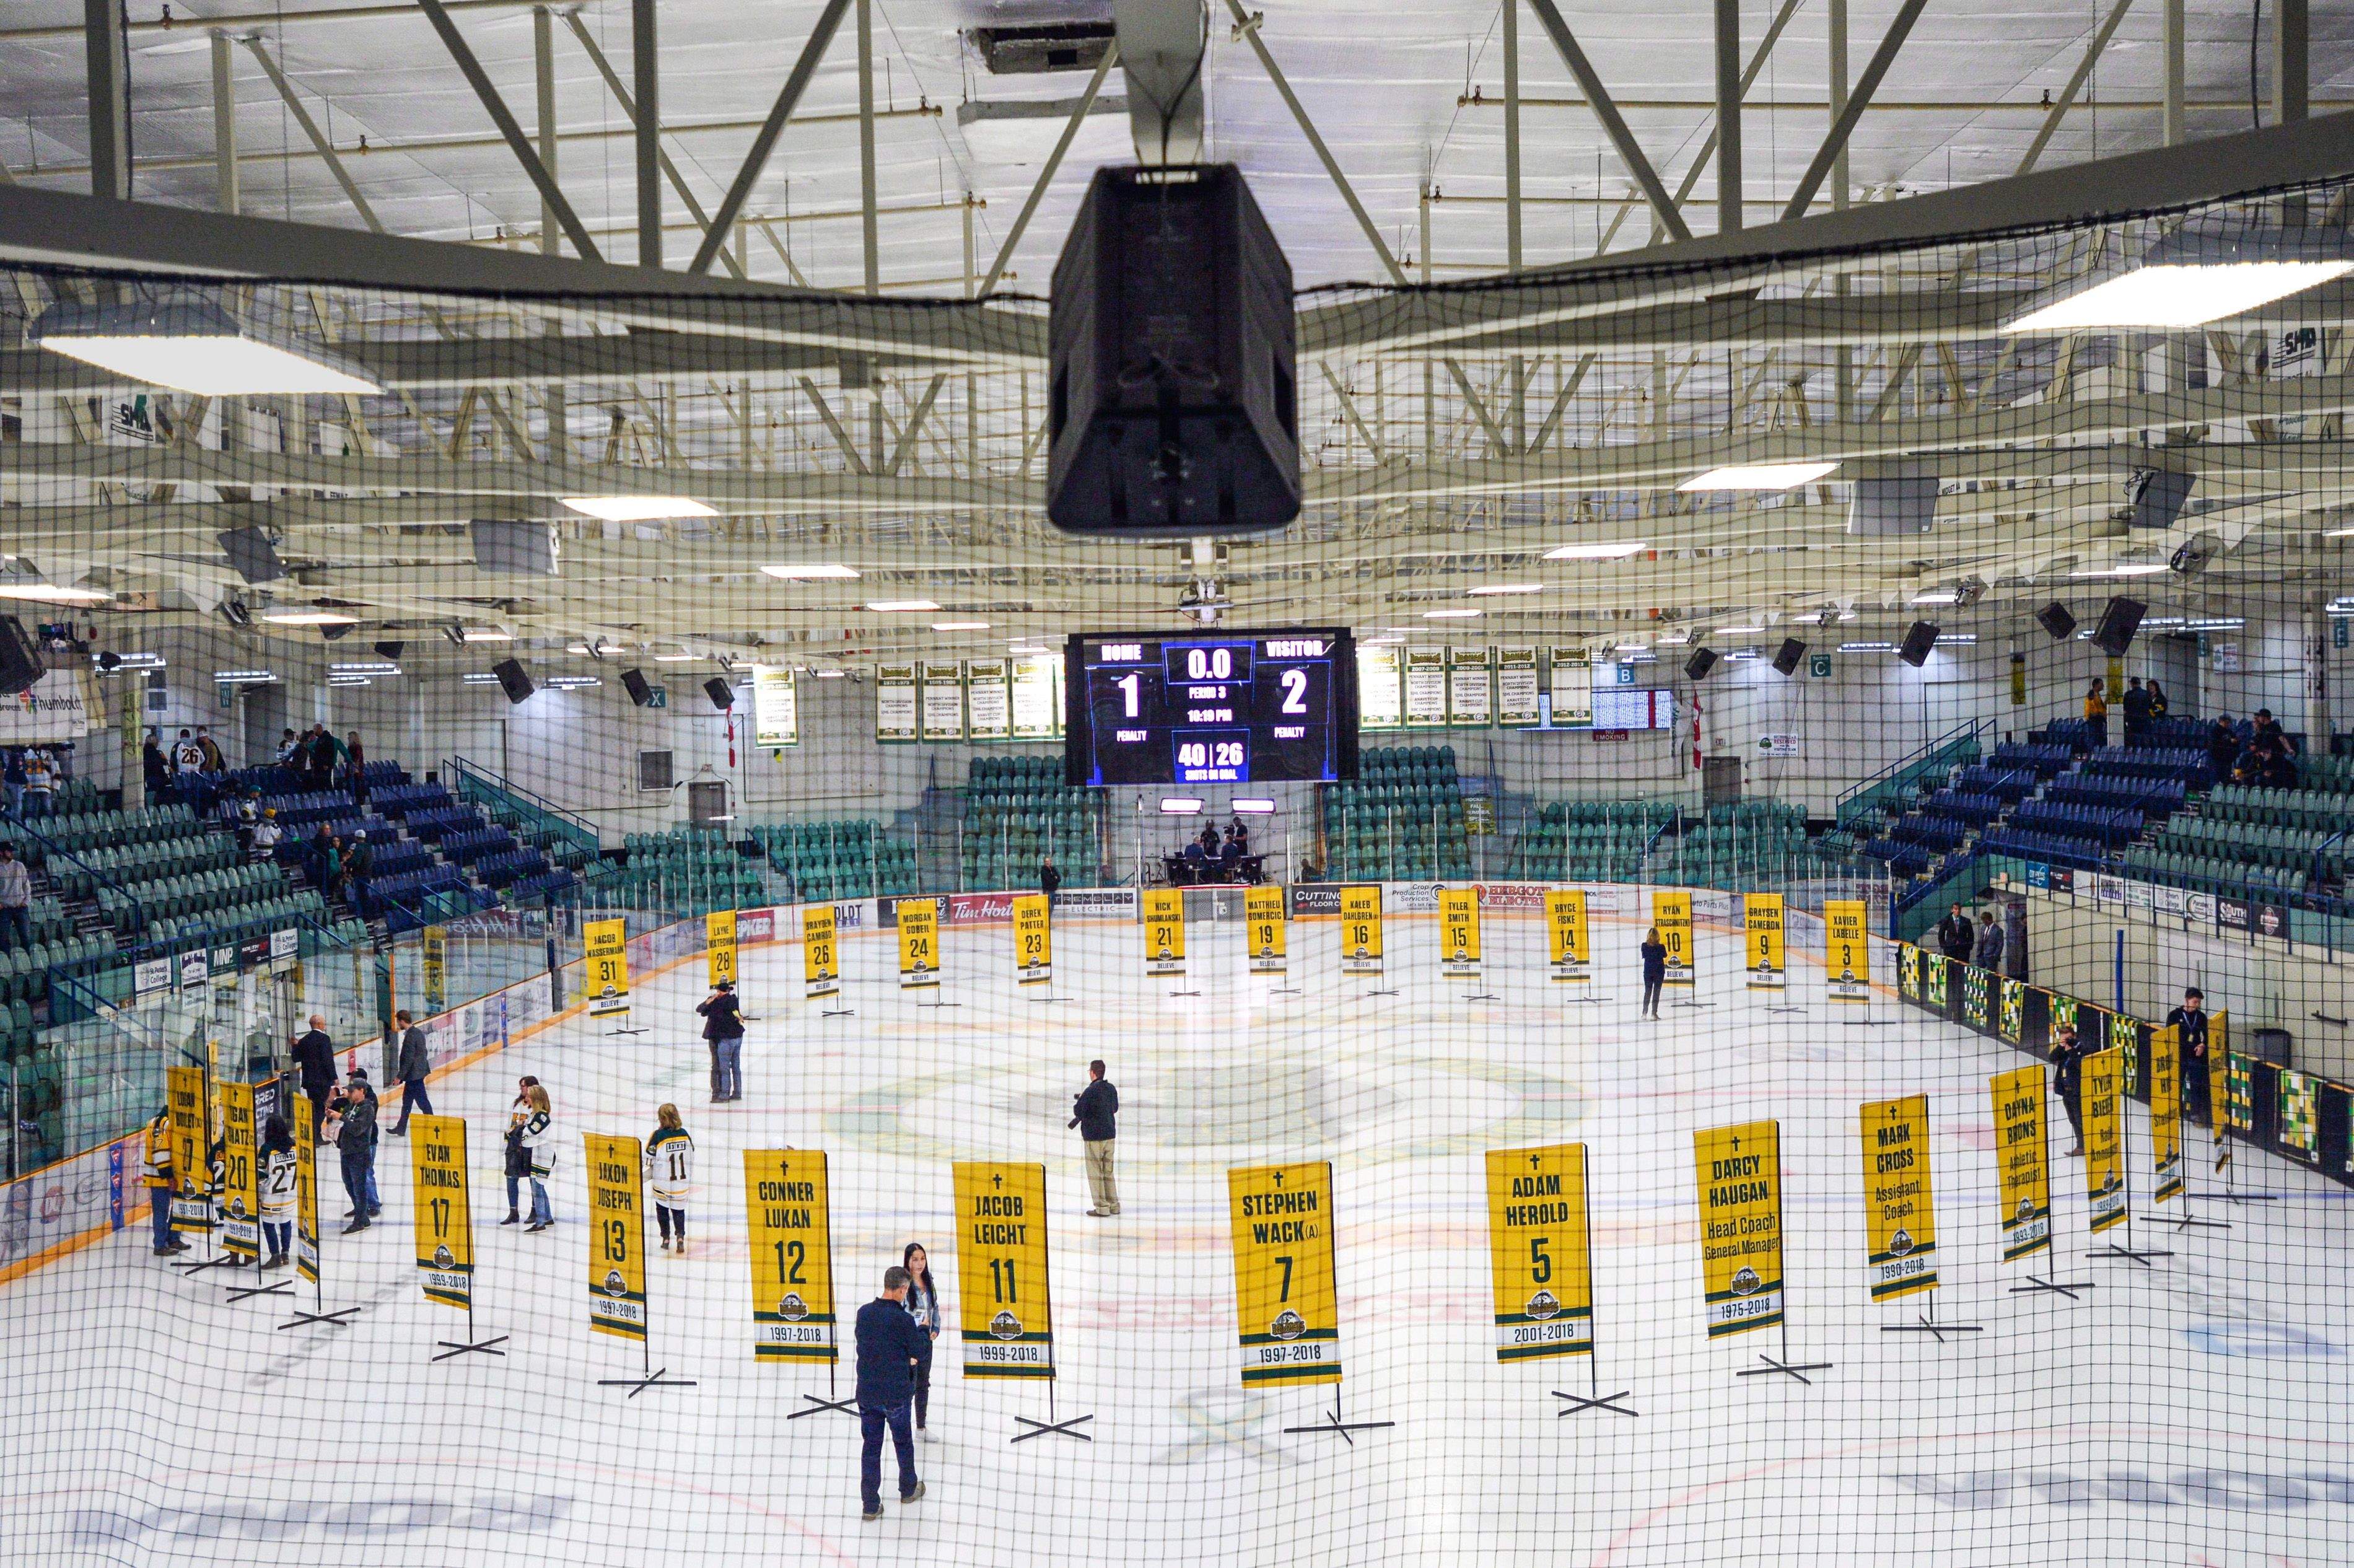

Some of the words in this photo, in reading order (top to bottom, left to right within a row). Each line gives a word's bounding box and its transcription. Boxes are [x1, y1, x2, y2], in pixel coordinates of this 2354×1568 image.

[1101, 645, 1141, 660] HOME
[1266, 641, 1323, 657] VISITOR
[1188, 649, 1231, 679] 0.0
[1815, 662, 1826, 675] C
[1621, 669, 1630, 681] B
[652, 693, 661, 706] X
[1118, 675, 1138, 717] 1
[1189, 687, 1216, 699] PERIOD
[1219, 686, 1226, 699] 3
[1282, 670, 1306, 714] 2
[1216, 709, 1232, 721] PM
[1117, 731, 1147, 742] PENALTY
[1274, 727, 1304, 738] PENALTY
[181, 748, 199, 764] 26
[1178, 744, 1205, 766] 40
[1216, 743, 1243, 765] 26
[1186, 770, 1207, 780] SHOTS
[1209, 769, 1220, 780] ON
[1222, 769, 1238, 780] GOAL
[1055, 895, 1132, 903] TREMBLAY
[1489, 886, 1551, 895] HERGOTT
[953, 901, 979, 919] Tim
[1021, 908, 1042, 919] DEREK
[1155, 902, 1171, 911] NICK
[1248, 900, 1280, 909] MATTHIEU
[1350, 901, 1370, 909] KALEB
[1449, 902, 1468, 911] TYLER
[1555, 904, 1576, 913] BRYCE
[1663, 906, 1680, 915] RYAN
[1749, 908, 1779, 918] GRAYSEN
[806, 918, 832, 930] BRAYDEN
[903, 913, 931, 922] MORGAN
[1020, 920, 1044, 930] PATTER
[1147, 914, 1181, 922] SHUMLANSKI
[1248, 911, 1282, 921] GOMERCIC
[1448, 913, 1469, 922] SMITH
[1557, 915, 1575, 924] FISKE
[1748, 920, 1780, 930] CAMERON
[1834, 916, 1857, 926] XAVIER
[714, 926, 729, 936] LAYNE
[807, 931, 832, 942] CAMRUD
[906, 924, 929, 934] GOBEIL
[1158, 927, 1172, 946] 21
[1259, 926, 1273, 944] 19
[1353, 926, 1368, 944] 16
[1452, 927, 1467, 947] 15
[1832, 929, 1859, 939] LABELLE
[593, 934, 616, 945] JACOB
[910, 939, 928, 958] 24
[1026, 934, 1041, 953] 23
[1560, 929, 1575, 950] 14
[1665, 932, 1681, 952] 10
[1760, 935, 1769, 955] 9
[214, 947, 233, 966] MNP
[587, 945, 624, 958] WASSERMANN
[814, 945, 829, 965] 26
[1842, 945, 1851, 966] 3
[600, 961, 616, 981] 31
[717, 952, 729, 972] 28
[815, 982, 830, 990] BELIEVE
[1757, 974, 1773, 982] BELIEVE
[600, 1000, 619, 1008] BELIEVE
[2005, 1096, 2035, 1121] DAYNA
[1877, 1123, 1910, 1148] MARK
[2007, 1121, 2036, 1145] BRONS
[426, 1143, 450, 1163] EVAN
[1877, 1149, 1914, 1173] CROSS
[2010, 1151, 2037, 1172] Athletic
[229, 1155, 247, 1191] 20
[599, 1162, 628, 1185] JAXON
[669, 1152, 686, 1181] 11
[1713, 1154, 1760, 1181] DARCY
[271, 1162, 297, 1194] 27
[420, 1167, 460, 1189] THOMAS
[1512, 1175, 1560, 1198] ADAM
[2008, 1167, 2041, 1190] Therapist
[598, 1188, 632, 1211] JOSEPH
[759, 1181, 814, 1202] CONNER
[1709, 1180, 1768, 1208] HAUGAN
[1876, 1180, 1919, 1203] Assistant
[974, 1196, 1023, 1217] JACOB
[1242, 1190, 1317, 1217] STEPHEN
[1884, 1201, 1914, 1221] Coach
[431, 1198, 450, 1238] 17
[765, 1208, 811, 1229] LUKAN
[1505, 1201, 1568, 1226] HEROLD
[974, 1224, 1026, 1245] LEICHT
[1253, 1220, 1304, 1245] WACK
[1305, 1223, 1318, 1239] (A)
[1707, 1219, 1737, 1239] Head
[1740, 1213, 1776, 1235] Coach
[2013, 1222, 2044, 1244] 1993-2018
[603, 1219, 626, 1263] 13
[1705, 1241, 1740, 1261] General
[1742, 1237, 1779, 1256] Manager
[774, 1240, 807, 1285] 12
[1531, 1237, 1551, 1284] 5
[1881, 1258, 1925, 1280] 1990-2018
[429, 1273, 466, 1289] 1999-2018
[989, 1258, 1017, 1304] 11
[1275, 1256, 1293, 1303] 7
[600, 1301, 636, 1319] 1997-2018
[1721, 1297, 1770, 1319] 1975-2018
[770, 1326, 821, 1342] 1997-2018
[1515, 1323, 1574, 1343] 2001-2018
[979, 1346, 1038, 1362] 1999-2018
[1259, 1346, 1321, 1363] 1997-2018
